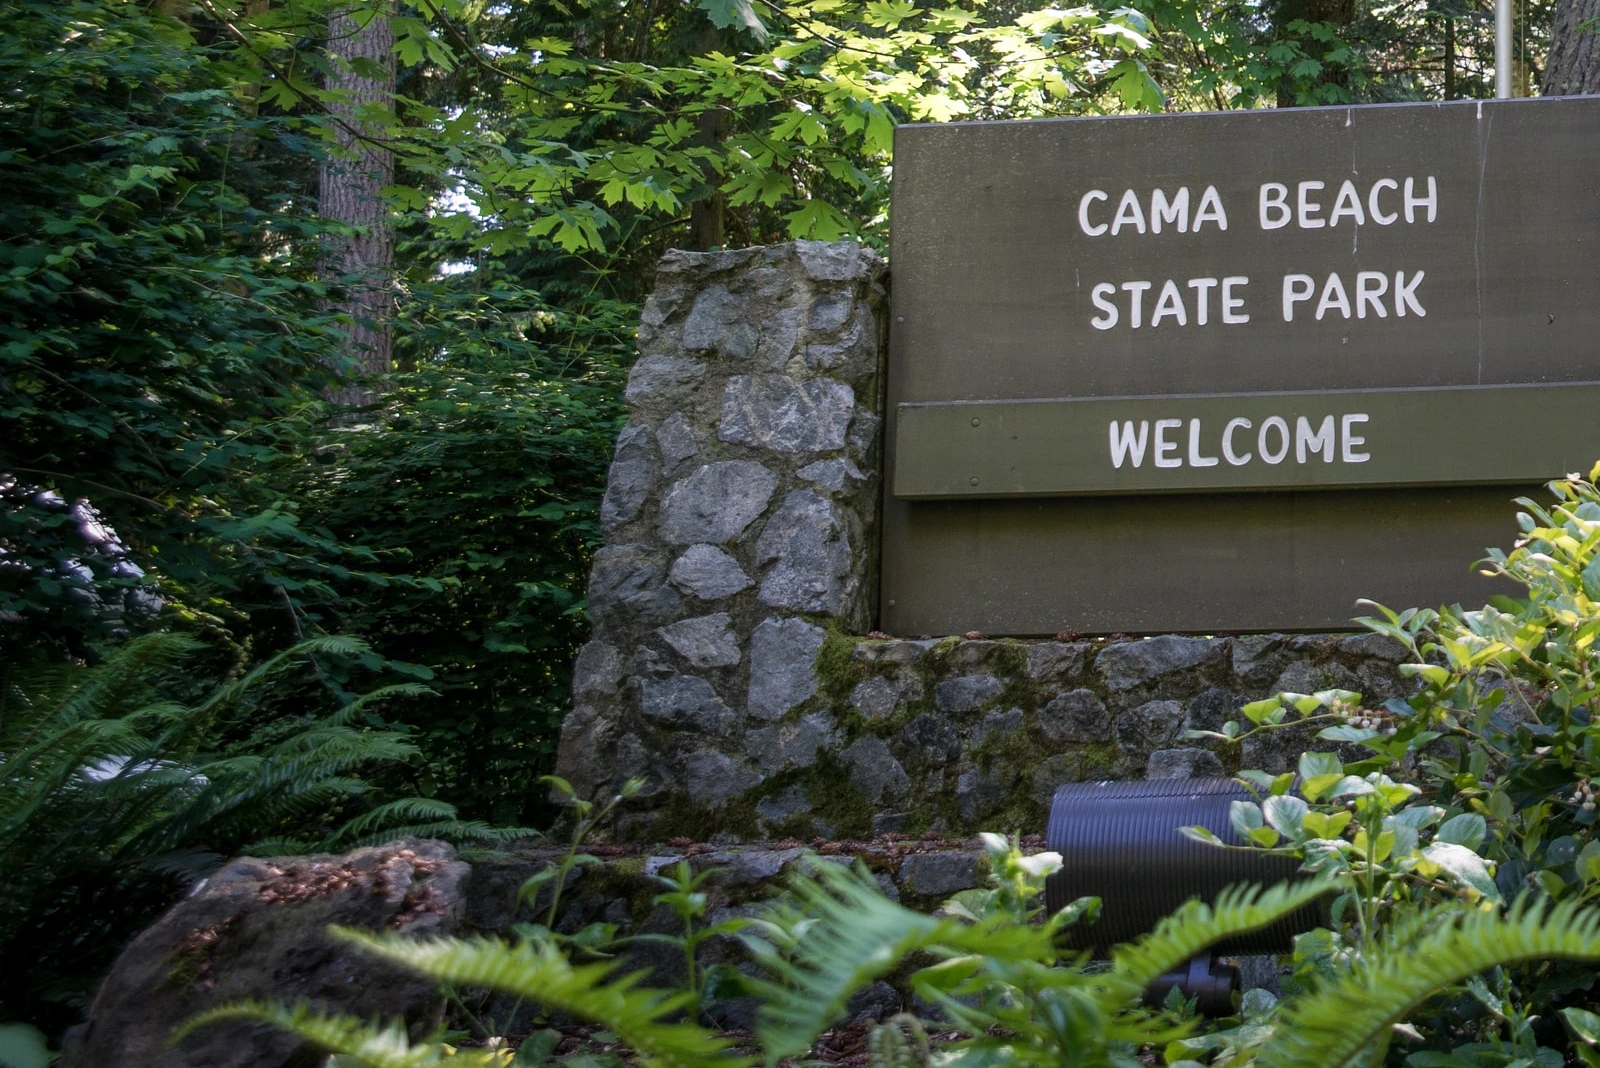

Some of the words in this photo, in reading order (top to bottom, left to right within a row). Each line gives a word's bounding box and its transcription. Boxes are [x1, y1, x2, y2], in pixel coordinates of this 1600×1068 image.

[1078, 185, 1228, 236] CAMA
[1259, 176, 1438, 230] BEACH
[1090, 276, 1250, 330] STATE
[1282, 270, 1427, 322] PARK
[1109, 413, 1371, 468] WELCOME
